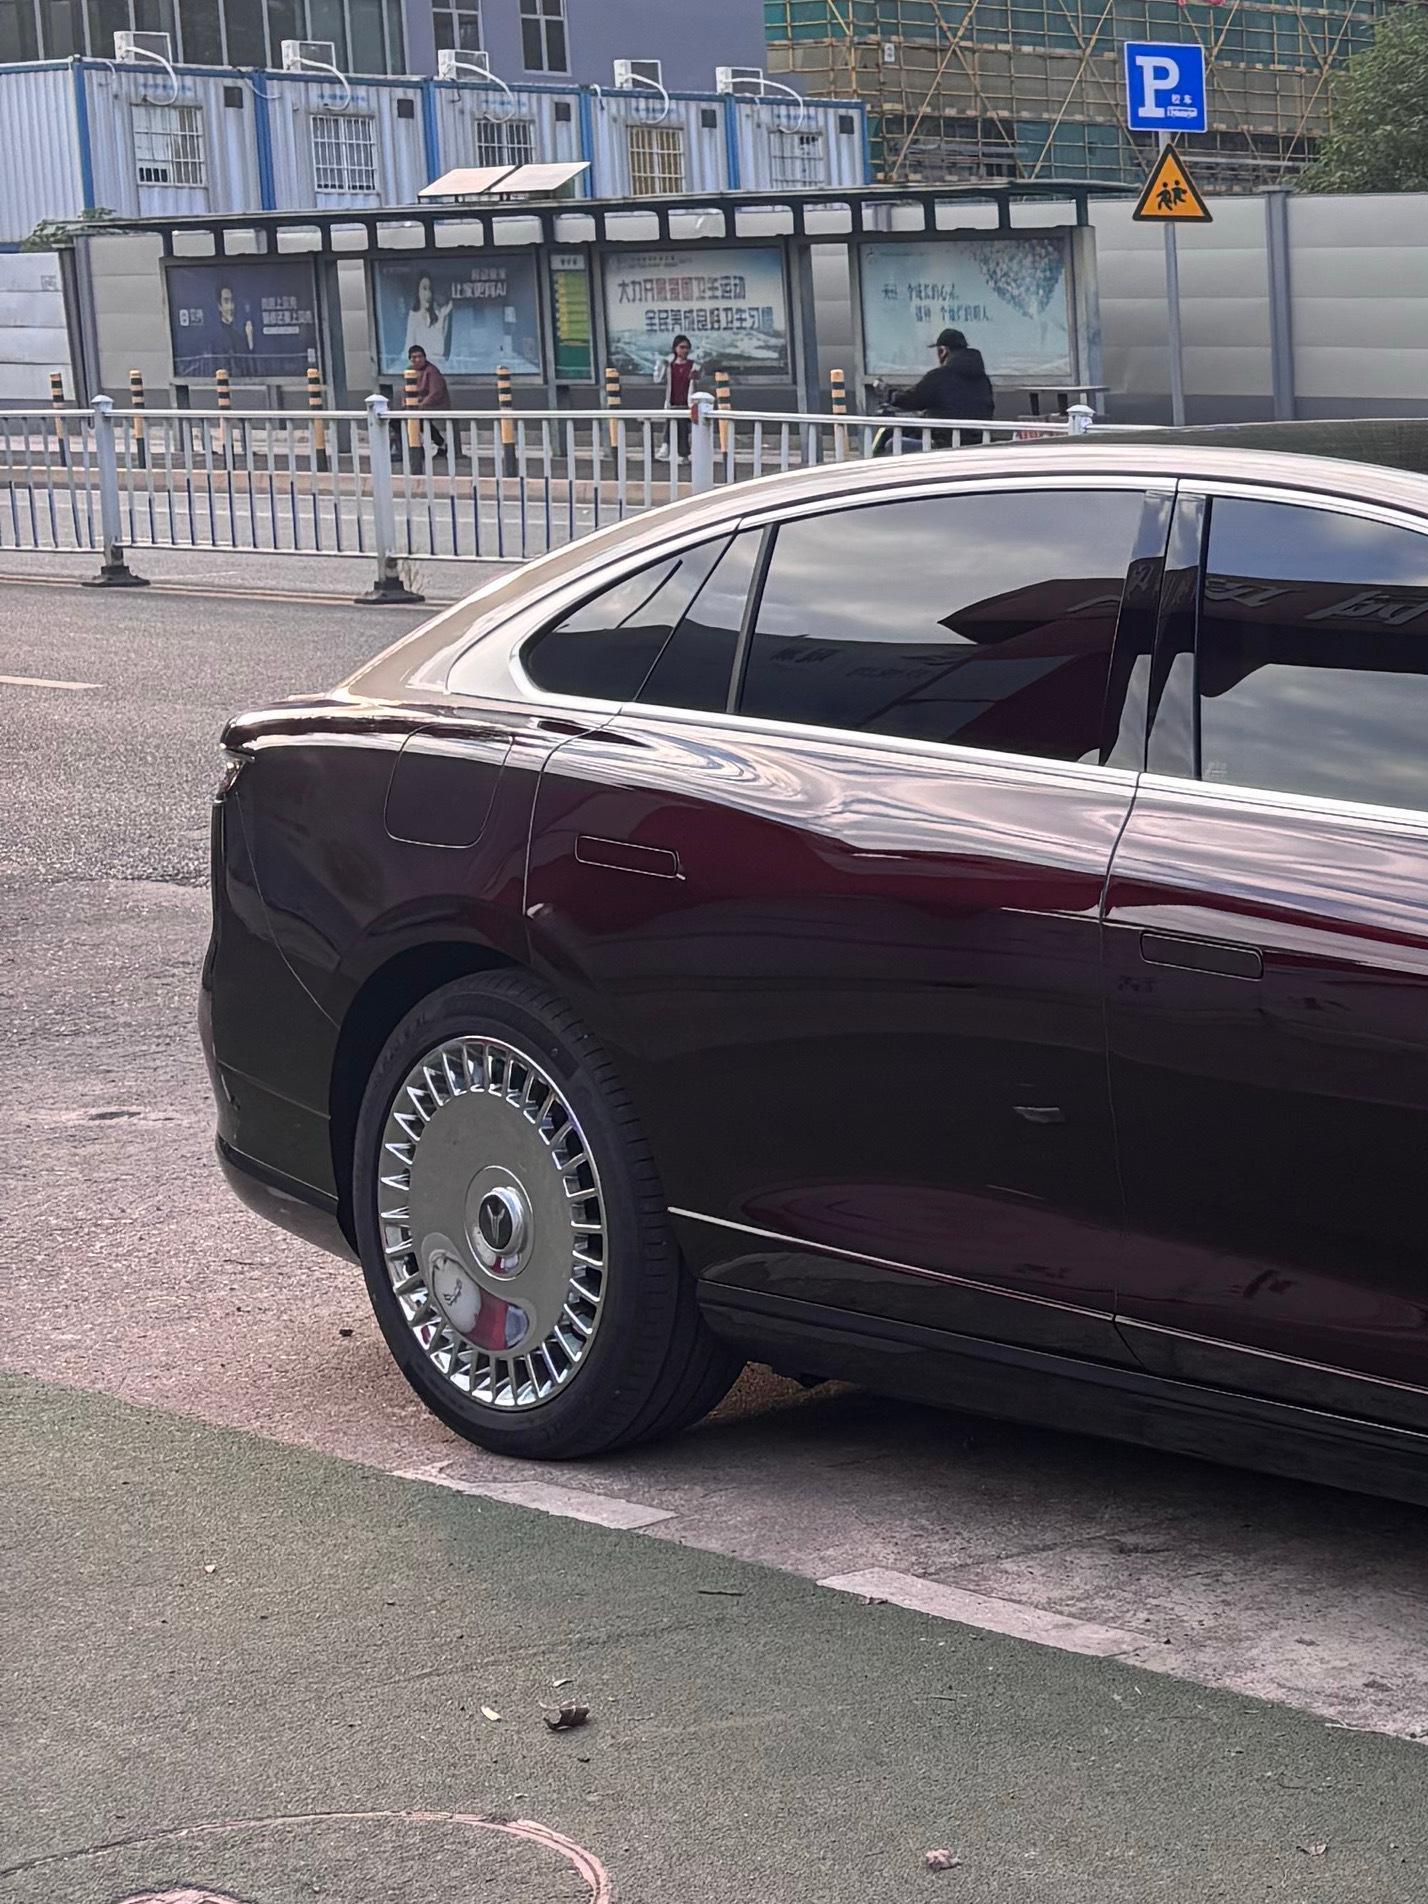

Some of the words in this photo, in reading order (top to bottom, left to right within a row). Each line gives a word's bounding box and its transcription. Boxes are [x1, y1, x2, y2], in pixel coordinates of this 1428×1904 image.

[1135, 55, 1180, 118] P
[617, 275, 747, 304] 大力开展爱国卫生运动
[644, 305, 775, 334] 全民养成良好卫生习惯
